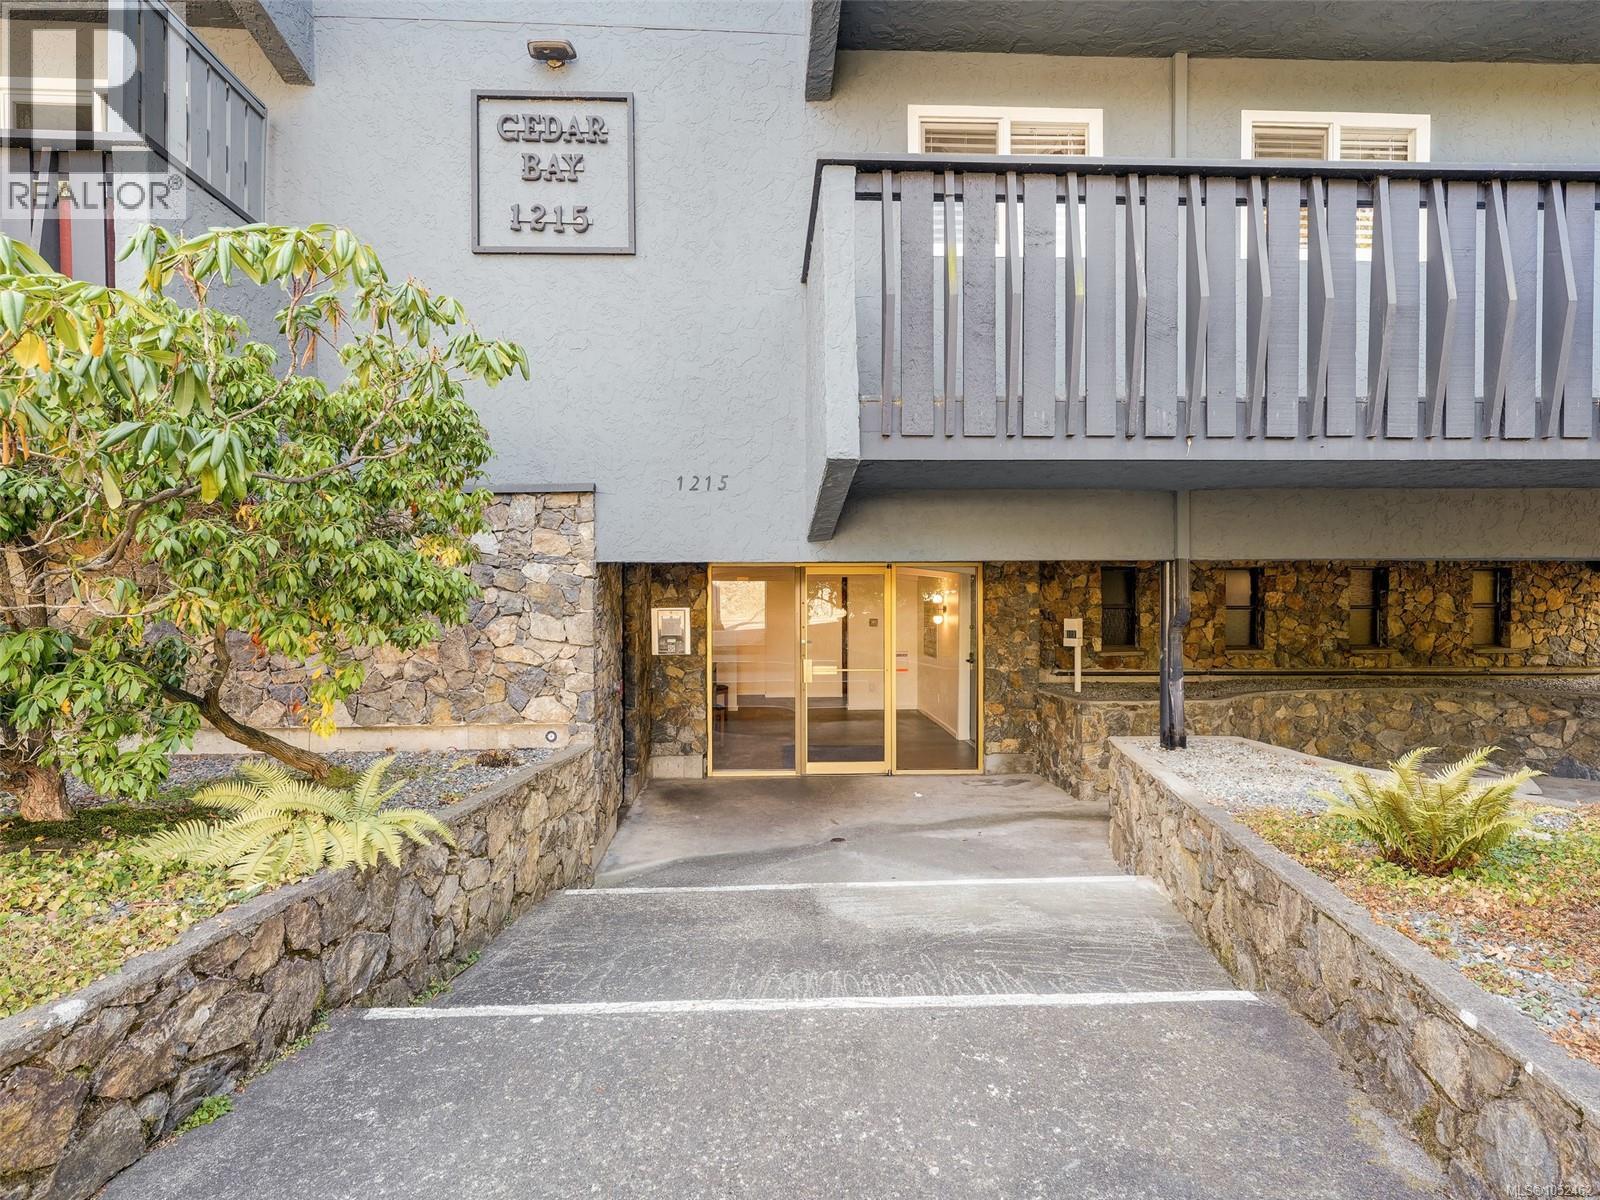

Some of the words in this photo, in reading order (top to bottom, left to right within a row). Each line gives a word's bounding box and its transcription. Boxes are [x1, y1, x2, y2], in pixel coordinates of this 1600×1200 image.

[497, 114, 608, 143] CEDAR
[521, 153, 584, 182] BAY
[510, 203, 590, 233] 1215
[677, 475, 728, 491] 1215
